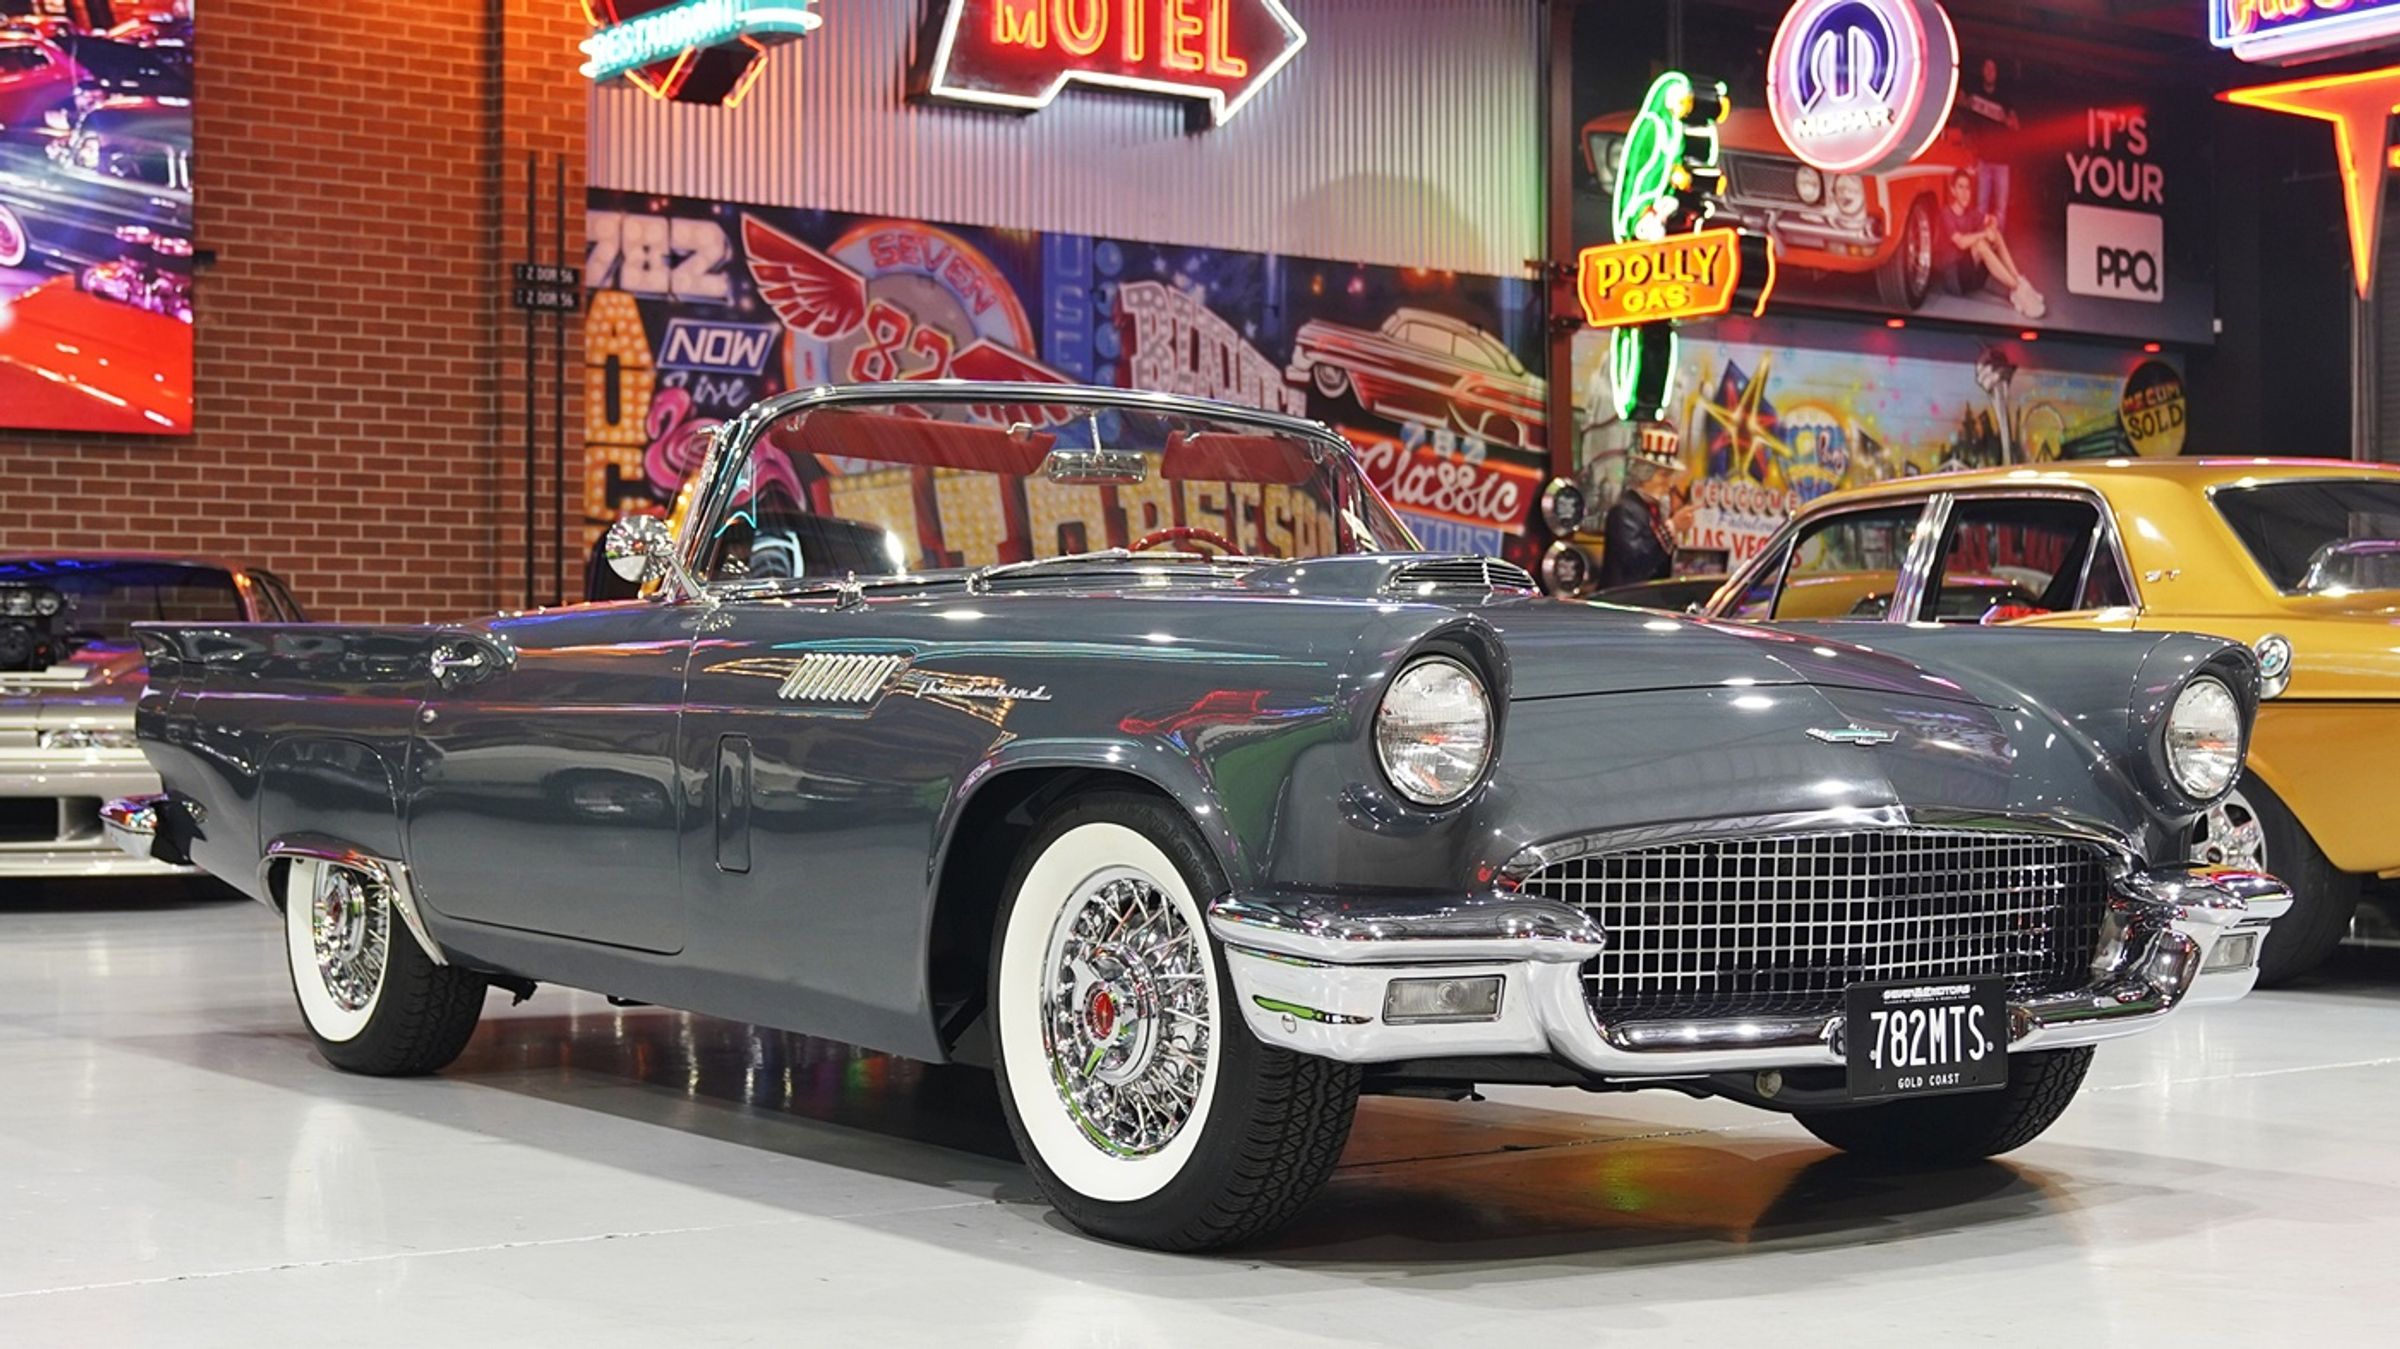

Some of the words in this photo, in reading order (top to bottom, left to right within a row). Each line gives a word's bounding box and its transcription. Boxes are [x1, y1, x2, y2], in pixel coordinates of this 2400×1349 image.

[996, 0, 1247, 78] MOTEL
[1793, 106, 1894, 139] MOPAR
[2087, 108, 2149, 156] IT'S
[2066, 152, 2165, 205] YOUR
[586, 210, 733, 302] 782
[867, 232, 997, 316] SEVEN
[1595, 244, 1721, 298] POLLY
[2097, 246, 2159, 293] PPQ
[1622, 283, 1687, 313] GAS
[666, 327, 768, 368] NOW
[849, 298, 953, 384] 82
[1402, 421, 1487, 465] 782
[2128, 403, 2184, 441] SOLD
[1353, 440, 1520, 522] Classic
[1869, 1004, 1986, 1070] 782MTS
[1897, 1076, 1923, 1089] GOLD
[1928, 1072, 1961, 1087] COAST
